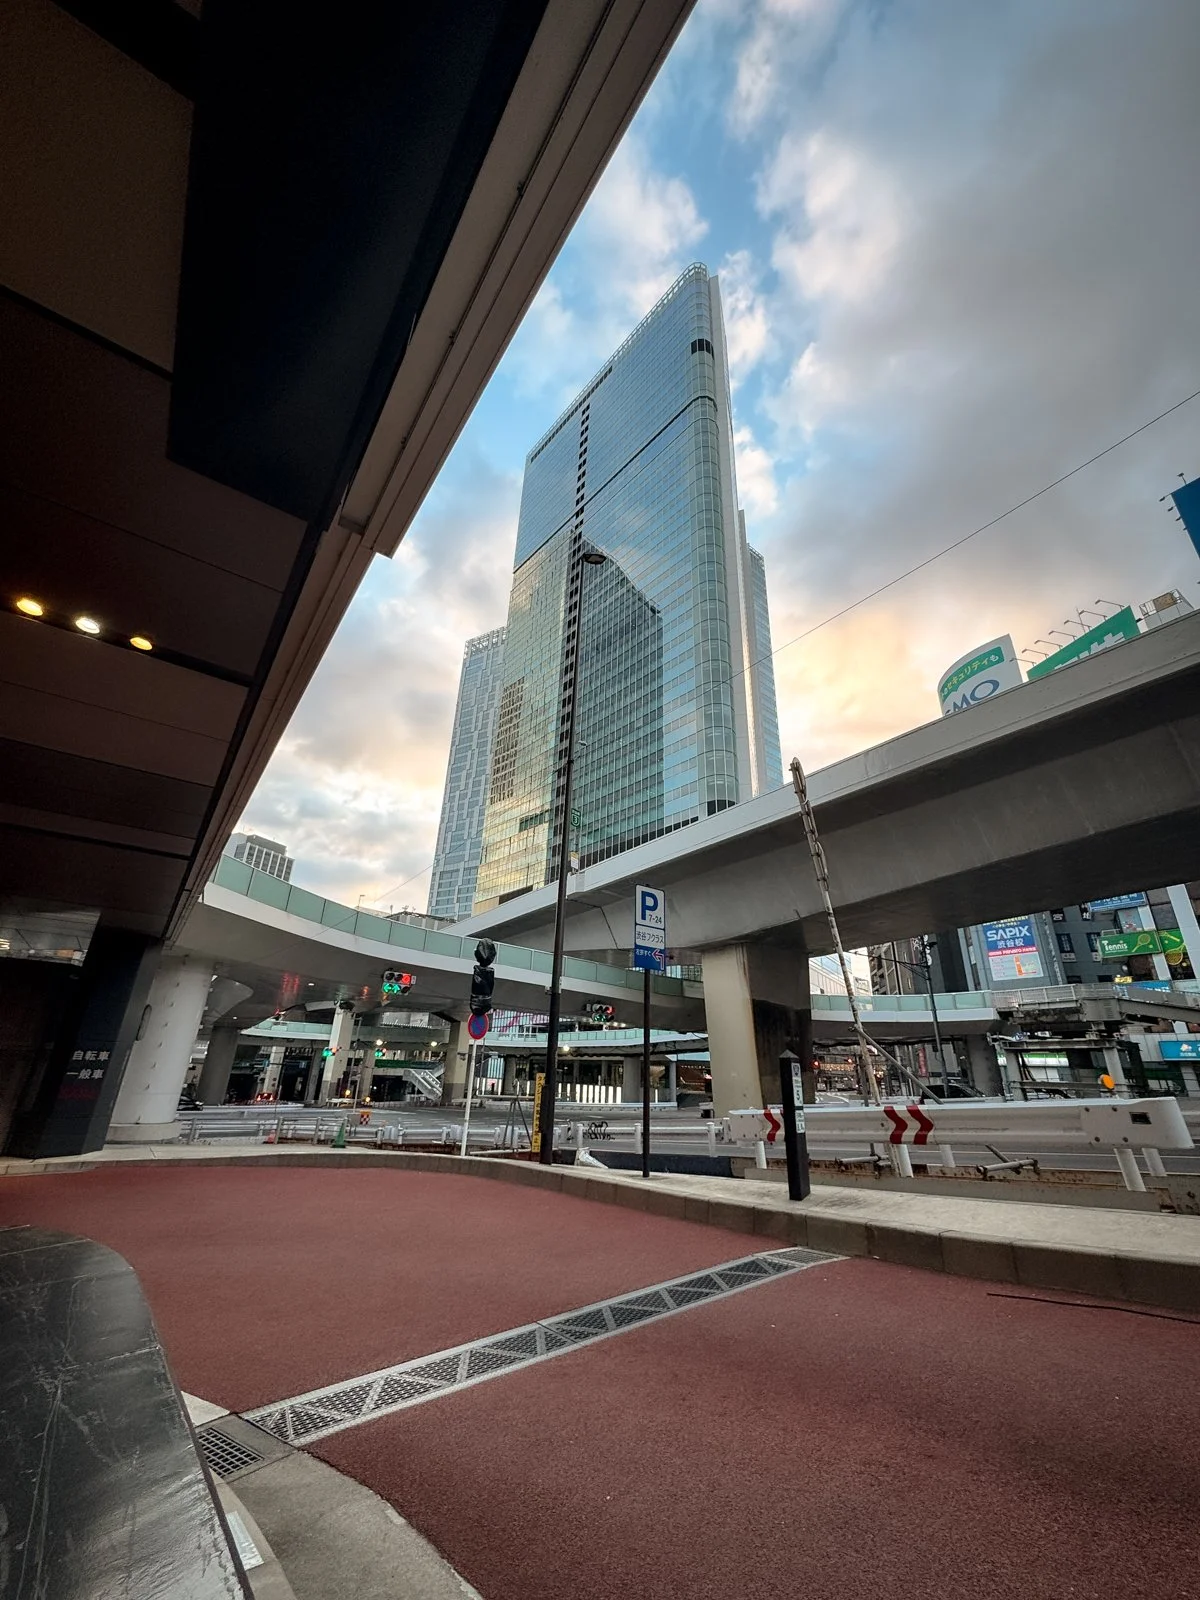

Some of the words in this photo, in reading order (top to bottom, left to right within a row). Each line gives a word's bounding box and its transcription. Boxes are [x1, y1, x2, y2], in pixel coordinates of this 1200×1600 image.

[945, 679, 1000, 716] MO
[641, 890, 659, 921] P
[648, 914, 663, 925] 7-24
[636, 930, 664, 944] 渋谷フクラス
[986, 925, 1032, 942] SAPIX
[1101, 940, 1128, 951] Tennis
[72, 1050, 111, 1061] 自転車
[66, 1068, 105, 1080] 一般車
